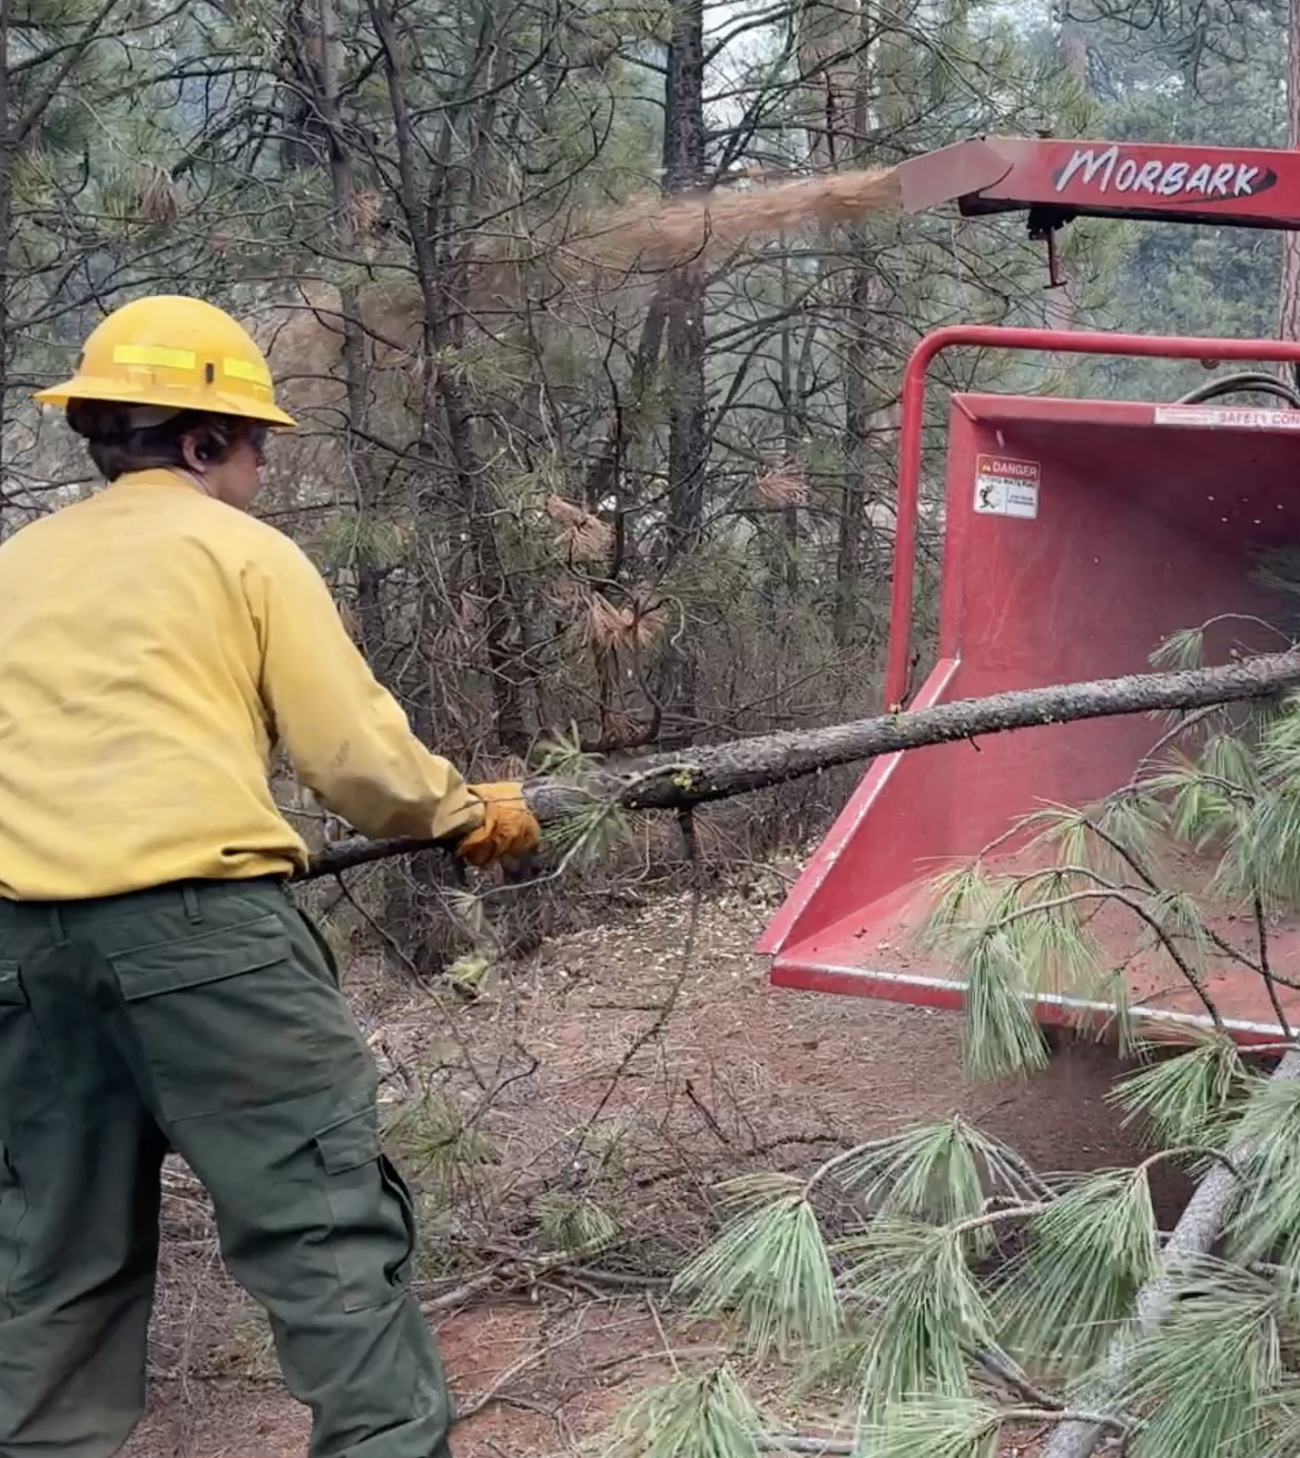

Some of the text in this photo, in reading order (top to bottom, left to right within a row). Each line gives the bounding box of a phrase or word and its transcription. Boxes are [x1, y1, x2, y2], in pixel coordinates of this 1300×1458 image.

[1055, 145, 1258, 195] MORBARK
[1220, 411, 1267, 425] SAFETY
[992, 461, 1037, 479] DANGER
